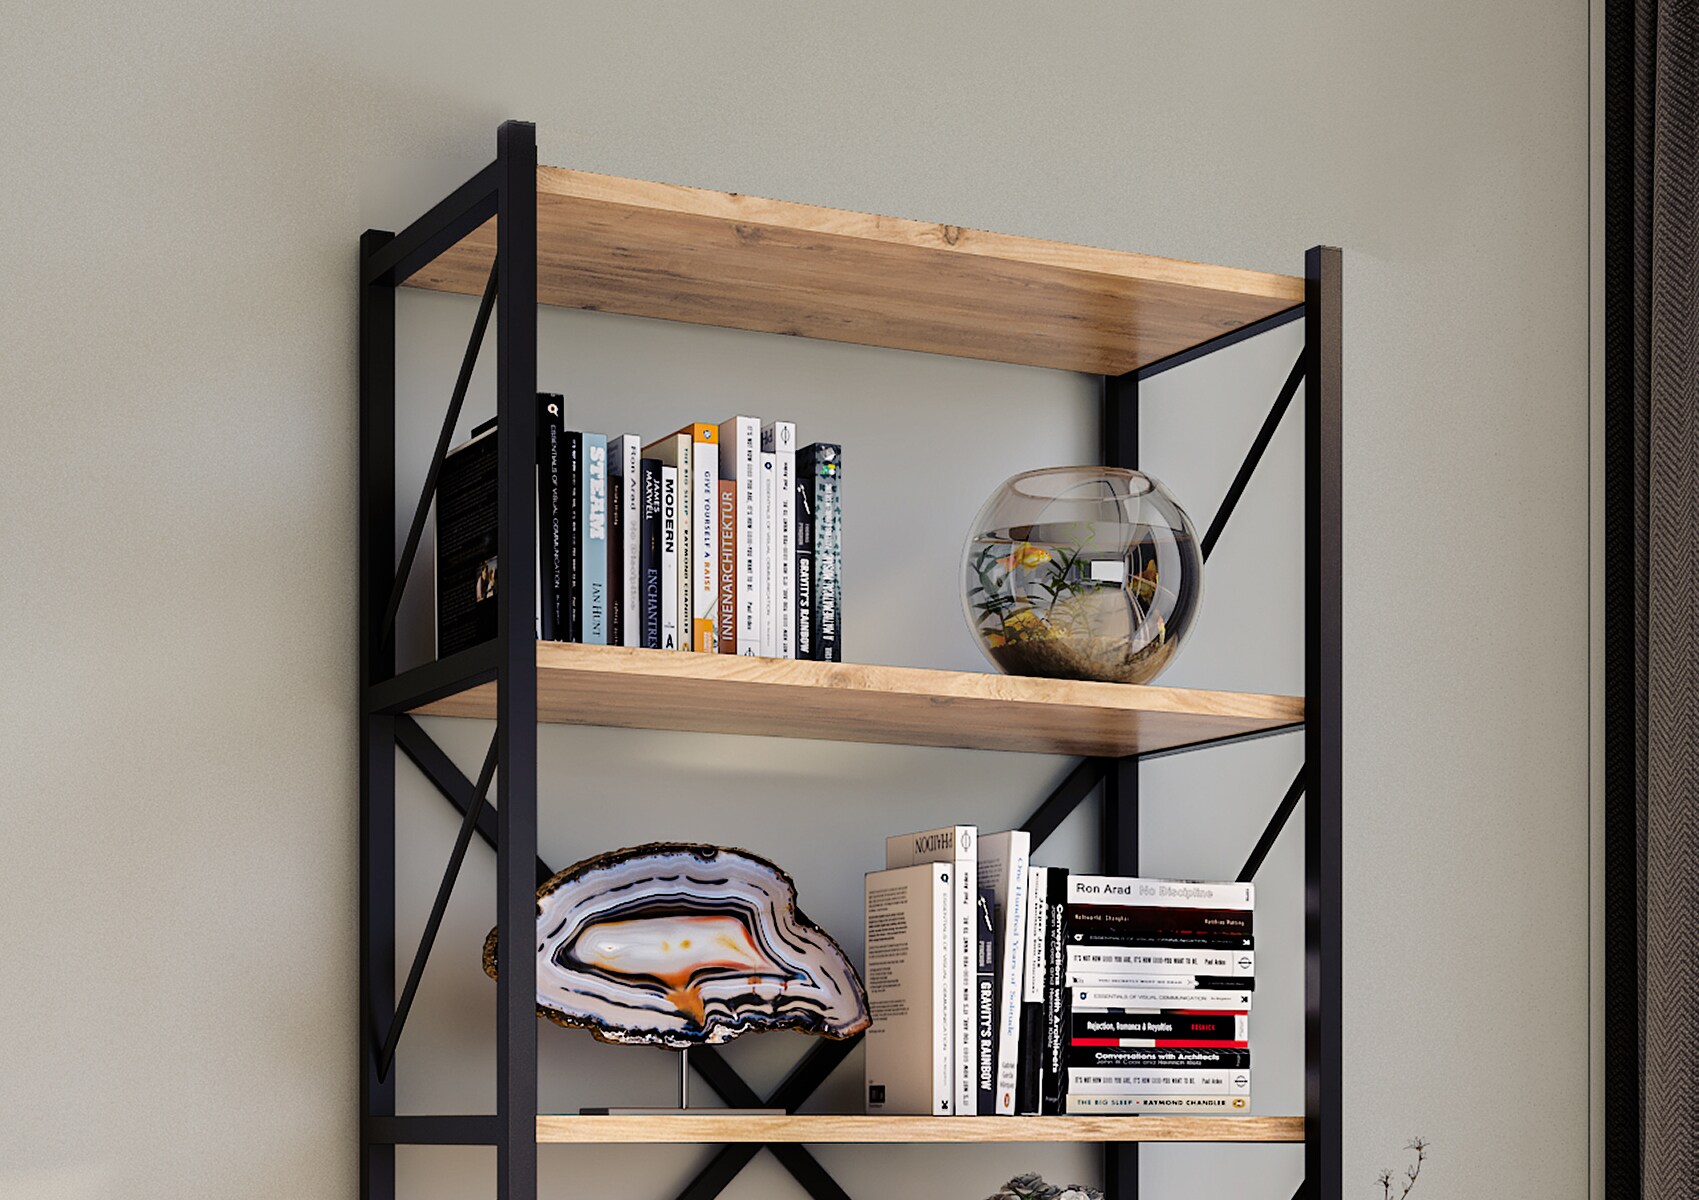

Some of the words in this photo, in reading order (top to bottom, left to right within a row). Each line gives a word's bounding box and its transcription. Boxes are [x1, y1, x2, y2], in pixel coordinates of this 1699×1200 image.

[550, 425, 558, 474] ESSENTIALS
[590, 446, 605, 540] STEAM
[646, 471, 654, 520] MAXWELL
[703, 471, 711, 494] GIVE
[665, 479, 674, 553] MODERN
[703, 498, 711, 548] YOURSELF
[703, 551, 711, 559] A
[703, 562, 711, 592] RAISE
[722, 491, 734, 641] INNENARCHITEKTUR
[592, 583, 602, 602] IAN
[800, 558, 810, 606] GRAVITY'S
[592, 605, 602, 638] HUNT
[647, 569, 658, 649] ENCHANTRES
[800, 607, 810, 654] RAINBOW
[1076, 884, 1100, 893] Ron
[1103, 884, 1131, 895] Arad
[1159, 887, 1214, 899] Discipline
[1054, 904, 1064, 987] Conversations
[981, 982, 993, 1037] GRAVITY'S
[1053, 988, 1062, 1013] with
[1051, 1015, 1061, 1073] Architects
[1087, 1021, 1115, 1032] Rejection,
[1116, 1022, 1141, 1031] Romance
[1147, 1022, 1173, 1032] Royalties
[981, 1039, 993, 1091] RAINBOW
[1095, 1052, 1157, 1060] Conversations
[1177, 1053, 1220, 1061] Architects
